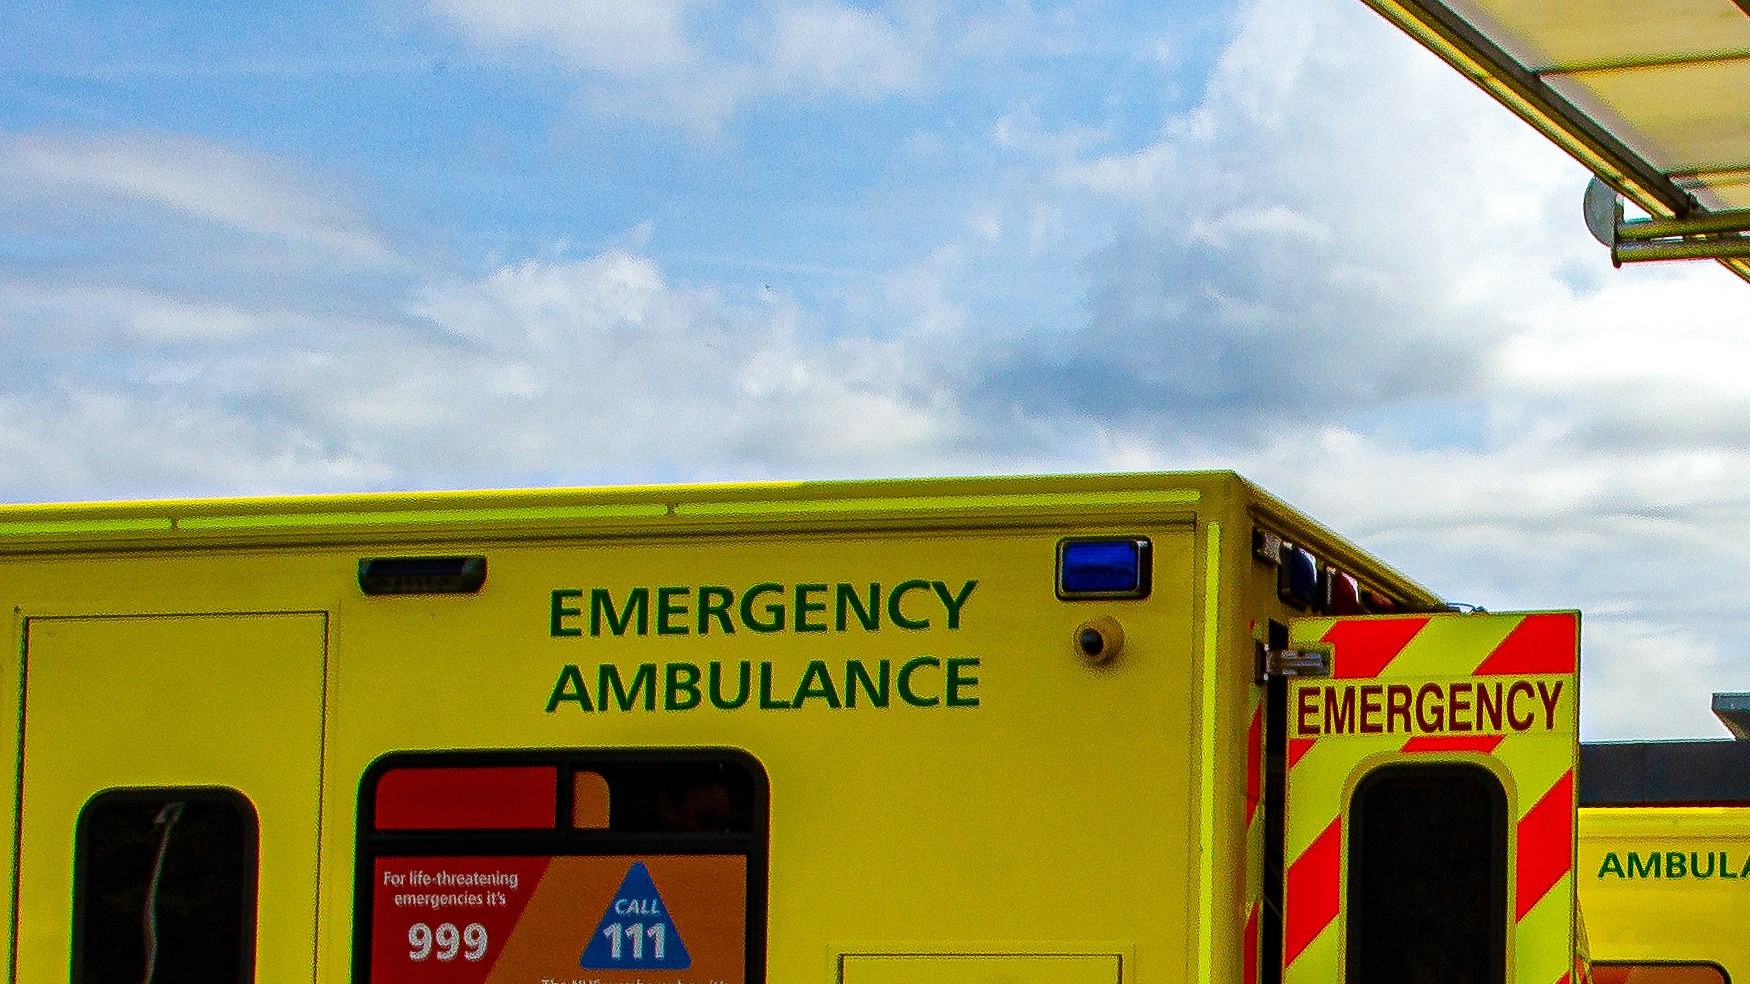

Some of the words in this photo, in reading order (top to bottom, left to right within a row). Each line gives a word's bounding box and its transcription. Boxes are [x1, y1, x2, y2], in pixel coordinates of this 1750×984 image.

[549, 579, 978, 637] EMERGENCY
[544, 656, 981, 713] AMBULANCE
[1297, 680, 1563, 734] EMERGENCY
[383, 872, 406, 886] For
[409, 871, 518, 889] life-threatening
[394, 892, 483, 909] emergencies
[487, 892, 506, 906] it's
[614, 898, 661, 916] CALL
[408, 922, 489, 962] 999
[603, 923, 666, 960] 111
